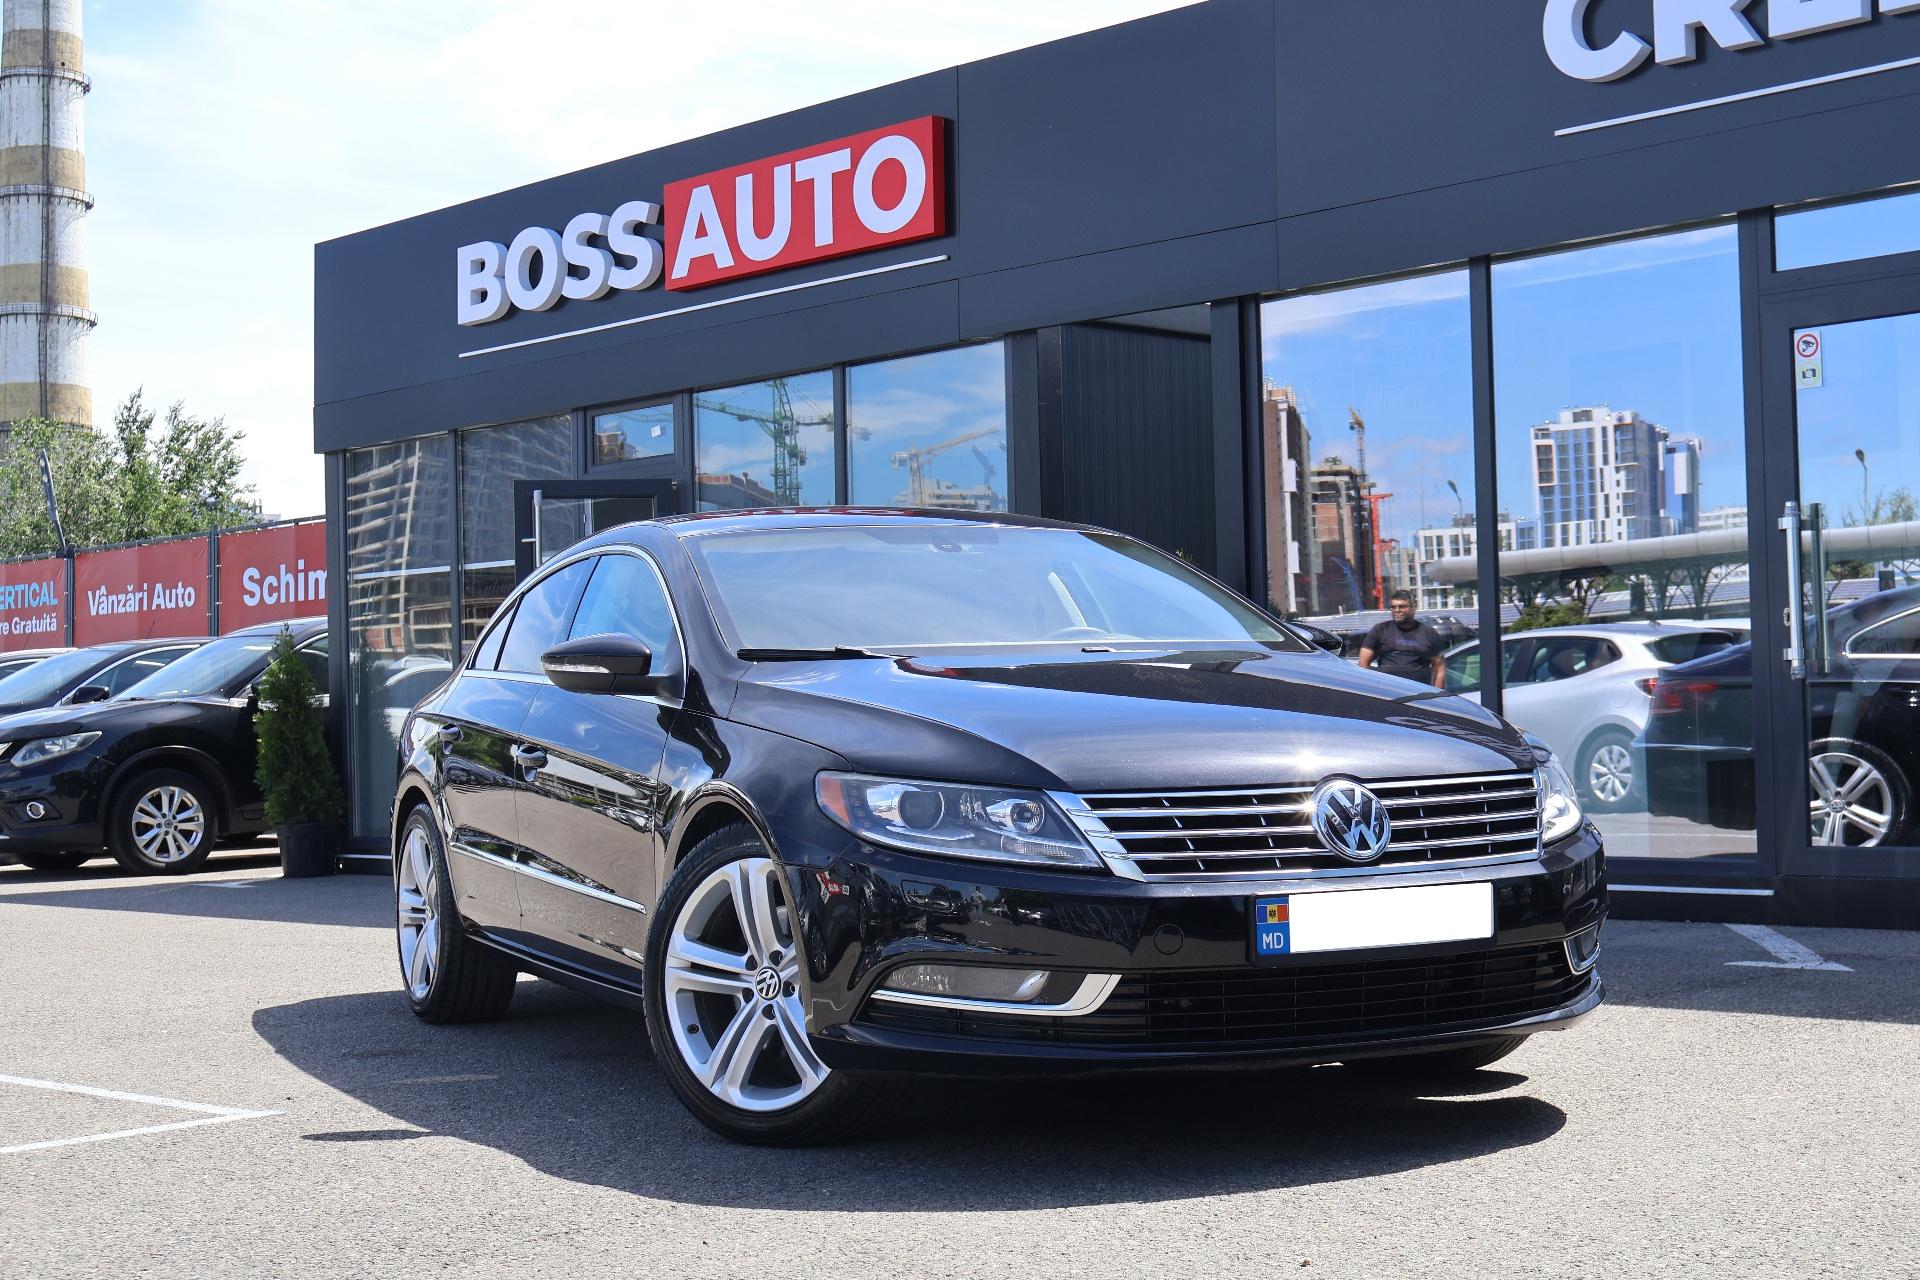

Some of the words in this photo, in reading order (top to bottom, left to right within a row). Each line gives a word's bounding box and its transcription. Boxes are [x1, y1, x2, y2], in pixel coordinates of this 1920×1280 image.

[458, 200, 664, 326] BOSS
[670, 135, 927, 281] AUTO
[87, 583, 149, 617] Vânzări
[151, 581, 196, 611] Auto
[11, 611, 57, 636] Gratuită
[1262, 932, 1284, 950] MD
